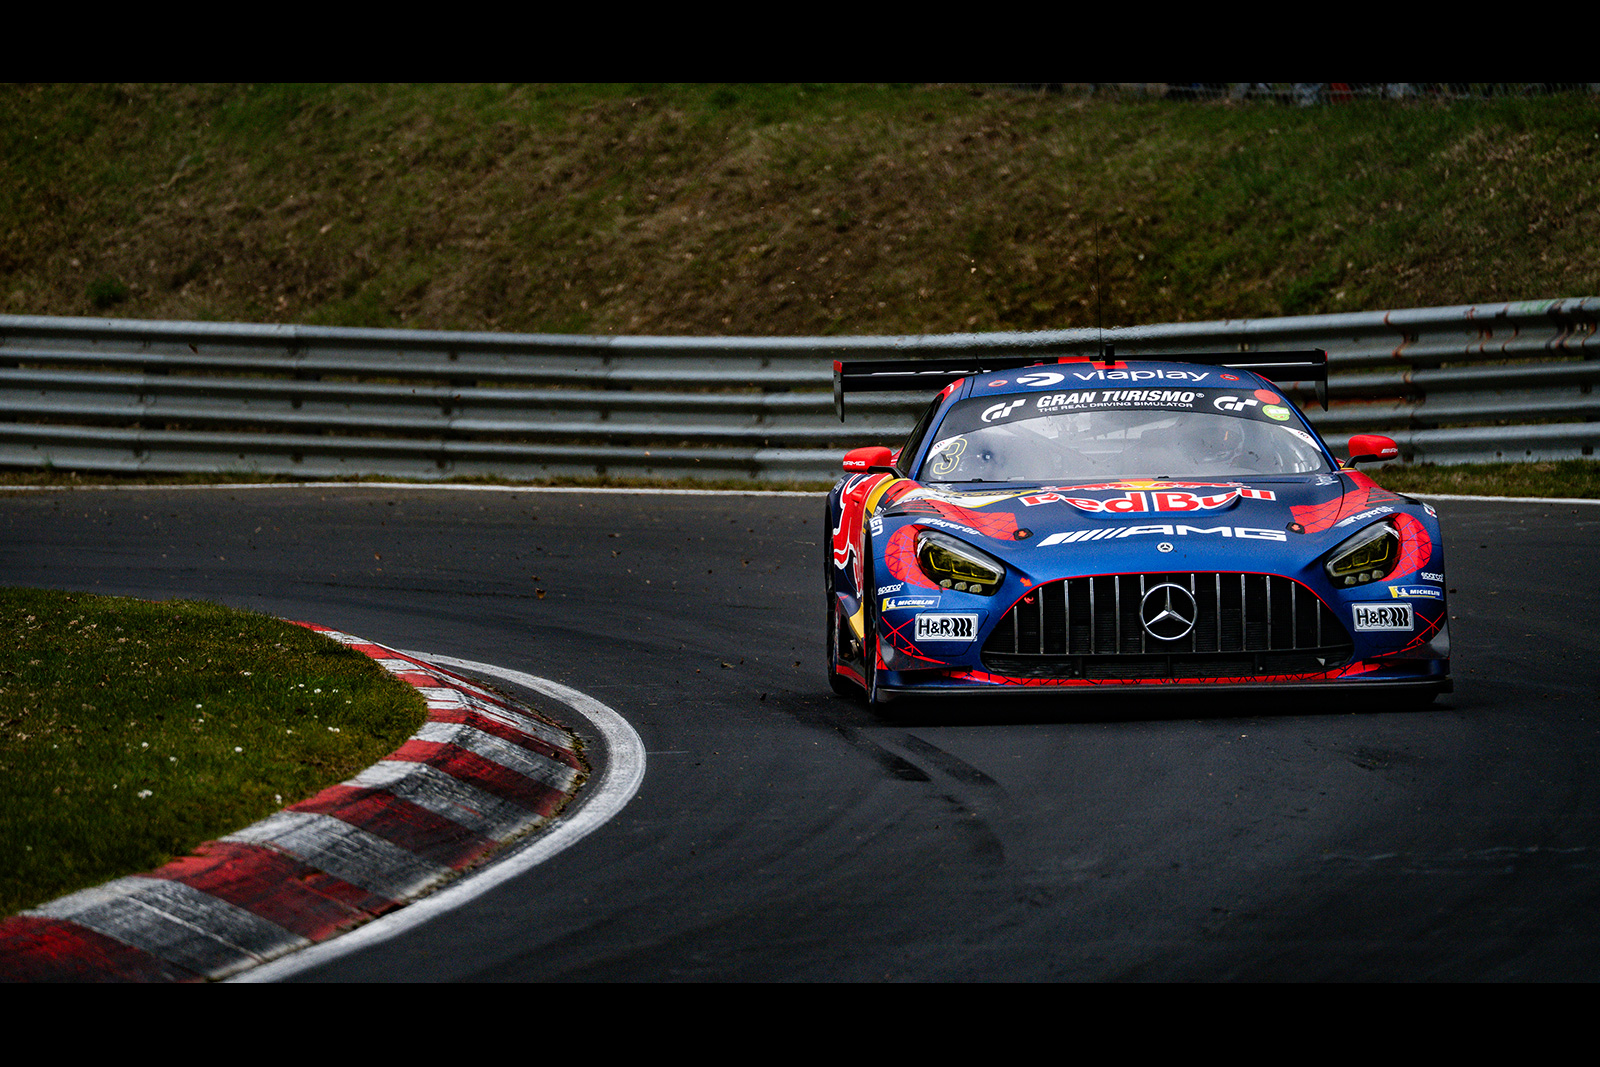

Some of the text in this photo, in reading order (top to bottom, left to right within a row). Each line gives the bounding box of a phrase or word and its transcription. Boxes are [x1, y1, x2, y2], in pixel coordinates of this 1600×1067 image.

[1073, 369, 1210, 382] viaplay
[1036, 391, 1097, 408] GRAN
[1060, 403, 1088, 411] REAL
[932, 437, 968, 475] 3
[1018, 487, 1277, 513] Red Bull
[1116, 524, 1288, 542] AMG
[1409, 588, 1441, 597] MICHELIN
[1355, 607, 1392, 628] H&R
[918, 617, 953, 638] H&R
